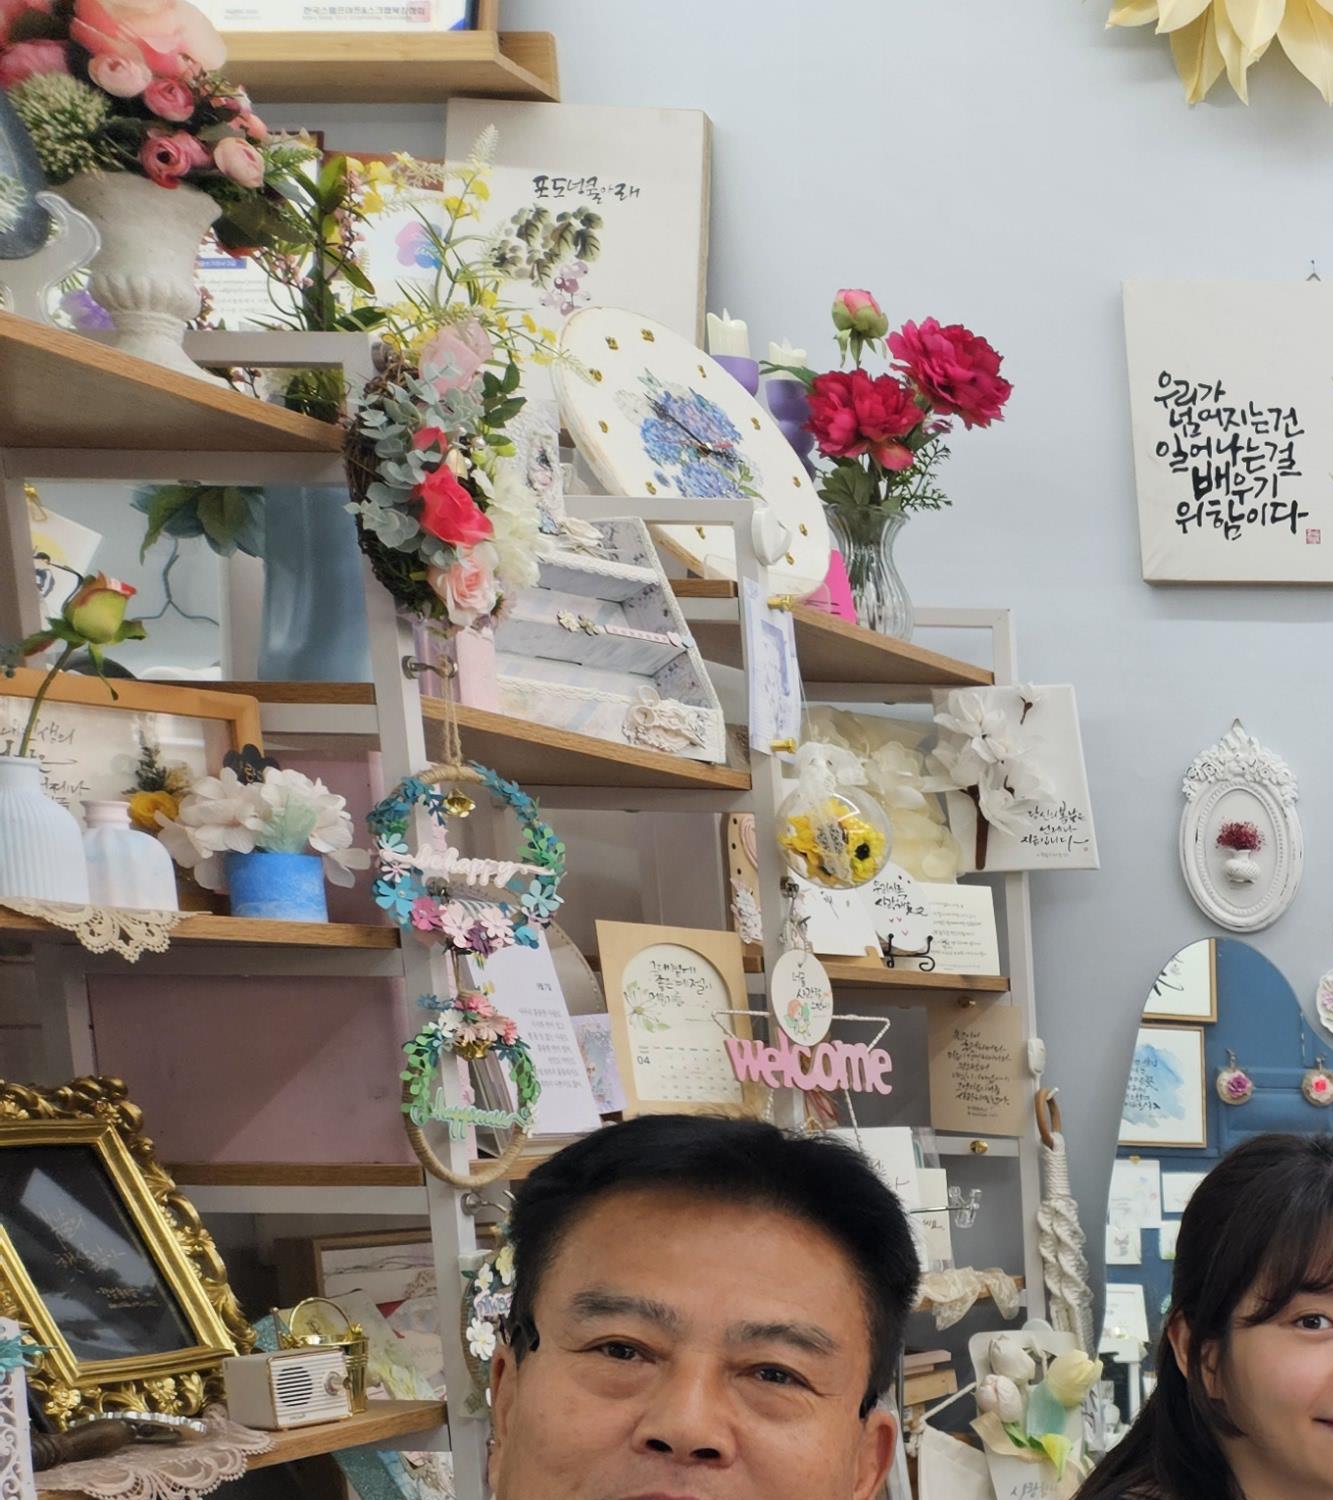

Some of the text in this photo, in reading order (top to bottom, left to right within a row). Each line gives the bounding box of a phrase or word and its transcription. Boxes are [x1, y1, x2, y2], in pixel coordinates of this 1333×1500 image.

[1153, 370, 1226, 407] 우리가
[1192, 466, 1278, 503] 배우기
[1176, 500, 1308, 541] 위함이다
